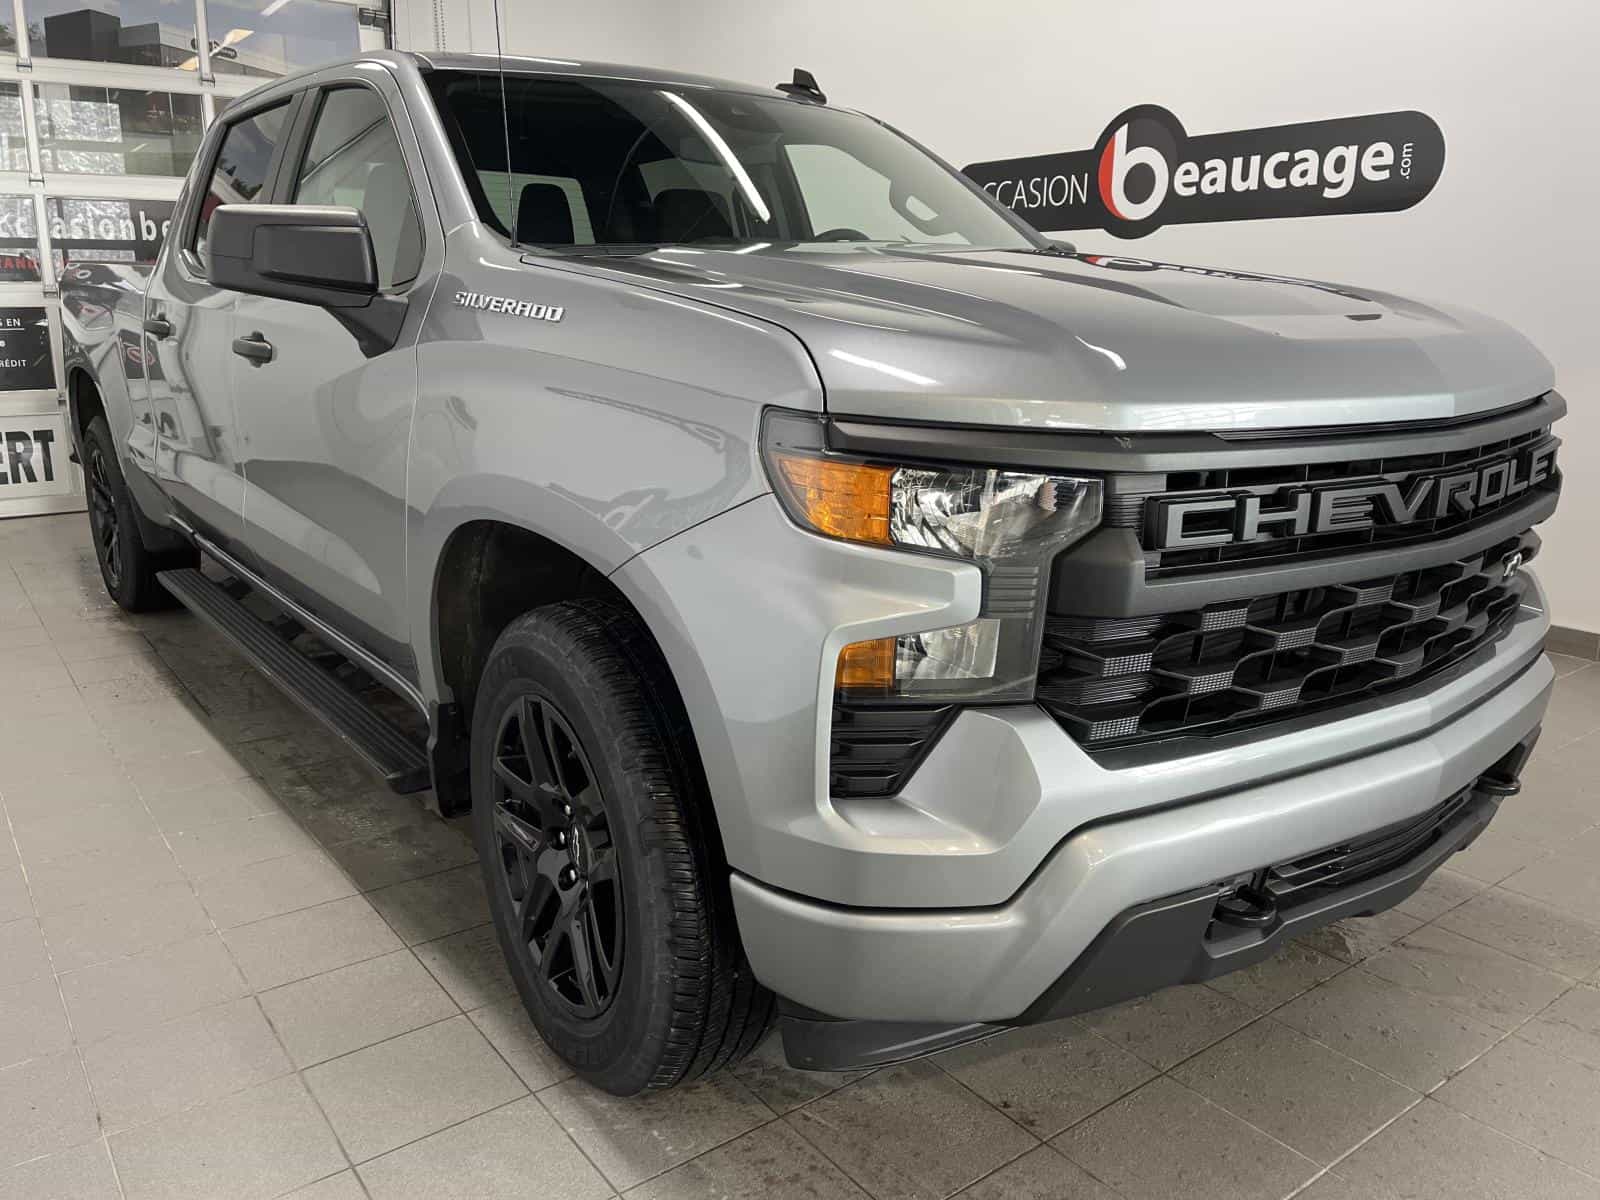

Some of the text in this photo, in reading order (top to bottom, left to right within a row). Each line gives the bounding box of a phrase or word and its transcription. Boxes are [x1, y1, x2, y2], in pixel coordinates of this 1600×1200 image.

[1112, 123, 1394, 221] beaucage
[6, 318, 21, 327] EN
[455, 291, 564, 322] SILVERADO
[1160, 438, 1558, 550] CHEVROLE
